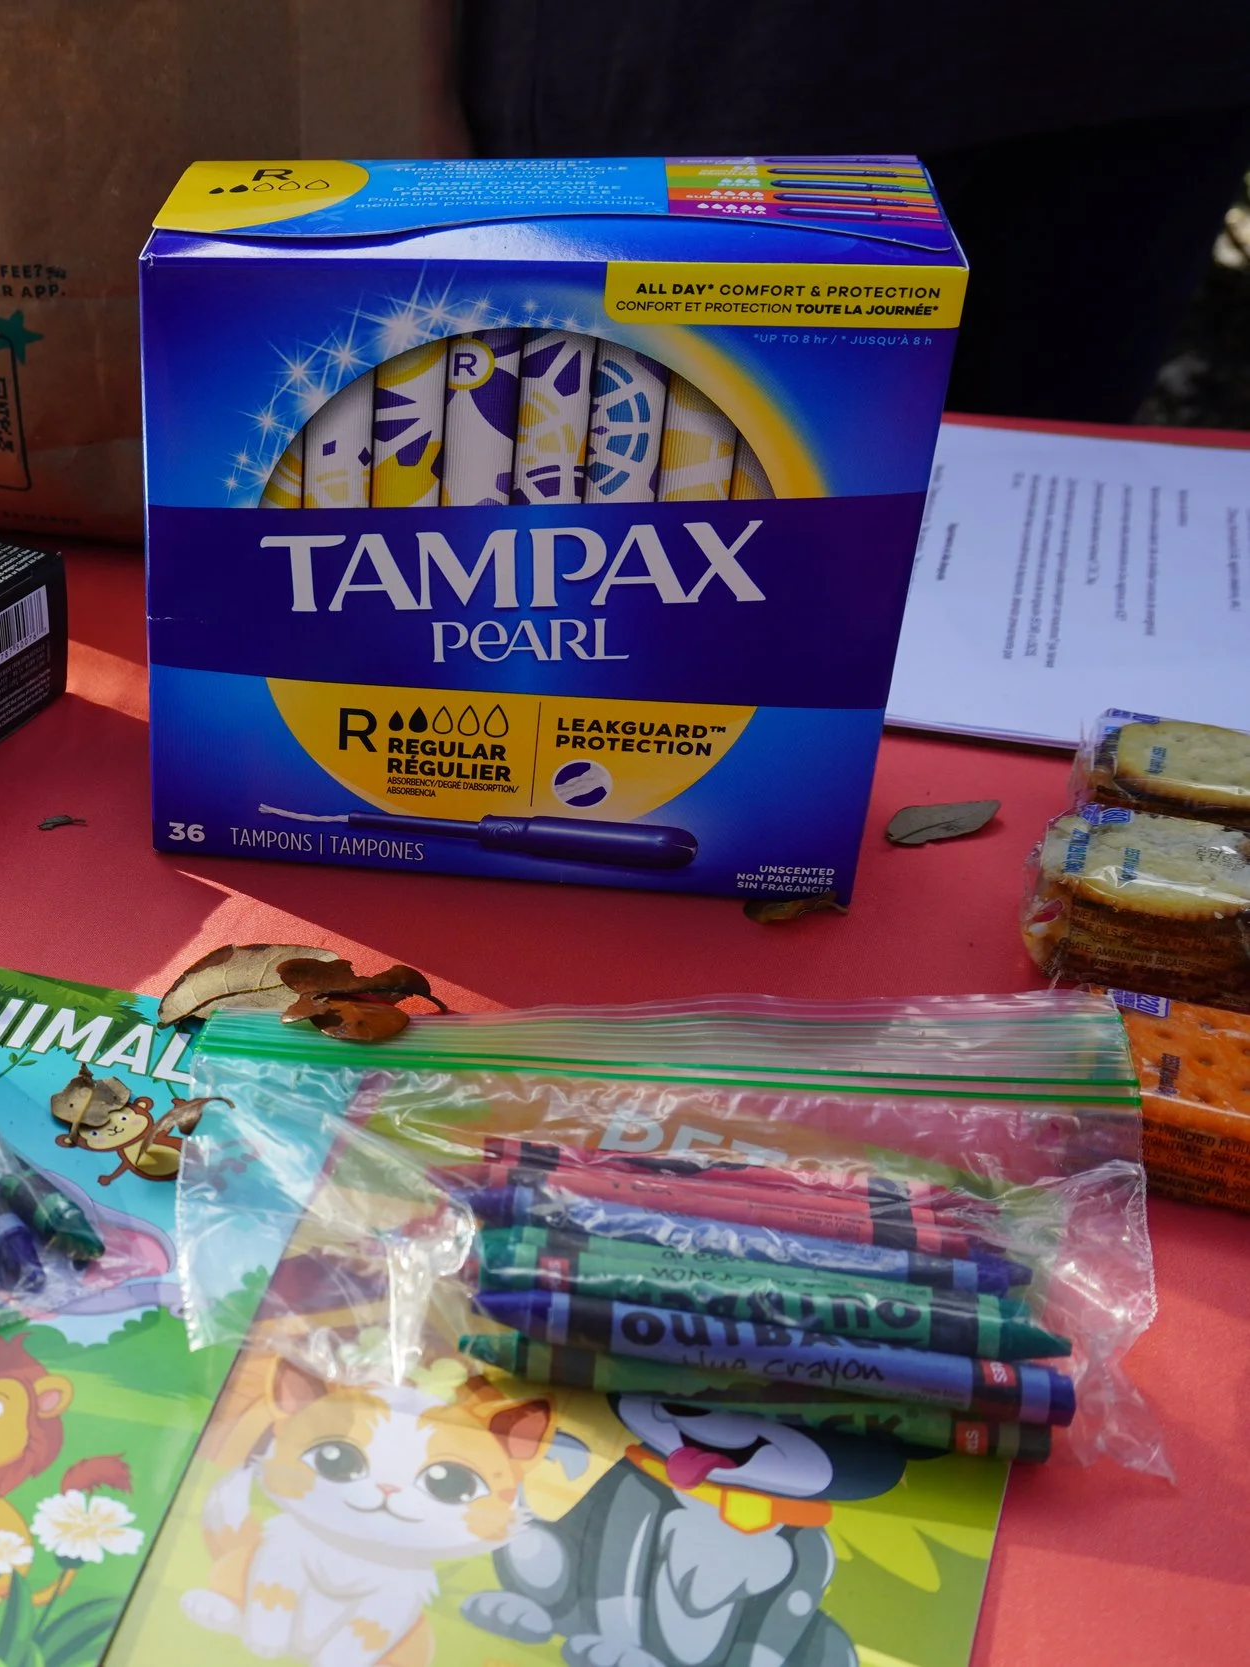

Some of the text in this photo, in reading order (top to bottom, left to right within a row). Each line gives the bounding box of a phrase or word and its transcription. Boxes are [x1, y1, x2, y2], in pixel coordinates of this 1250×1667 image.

[252, 168, 293, 181] R
[21, 284, 66, 299] APP.
[636, 283, 668, 295] ALL
[719, 284, 806, 297] COMFORT
[810, 285, 822, 297] &
[826, 286, 942, 299] PROTECTION
[616, 300, 681, 312] CONFORT
[684, 301, 703, 312] ET
[704, 302, 792, 314] PROTECTION
[795, 303, 843, 315] TOUTE
[844, 304, 863, 315] LA
[781, 334, 800, 344] TO
[802, 335, 811, 345] 8
[813, 334, 829, 345] hr
[850, 334, 910, 346] JUSQU'À
[913, 336, 922, 346] 8
[924, 336, 933, 346] h
[452, 352, 478, 377] R
[259, 519, 767, 613] TAMPAX
[338, 707, 378, 753] R
[388, 737, 507, 762] REGULAR
[554, 734, 714, 758] PROTECTION
[387, 755, 512, 782] RÉGULIER
[386, 786, 436, 798] ABSORBENCIA
[168, 821, 425, 861] 36 TAMPONS TAMPONES
[758, 865, 836, 877] UNSCENTED
[736, 873, 834, 886] NON PARFUMÉS
[737, 881, 832, 894] SIN FRAGANCIA
[762, 1357, 888, 1385] crayon
